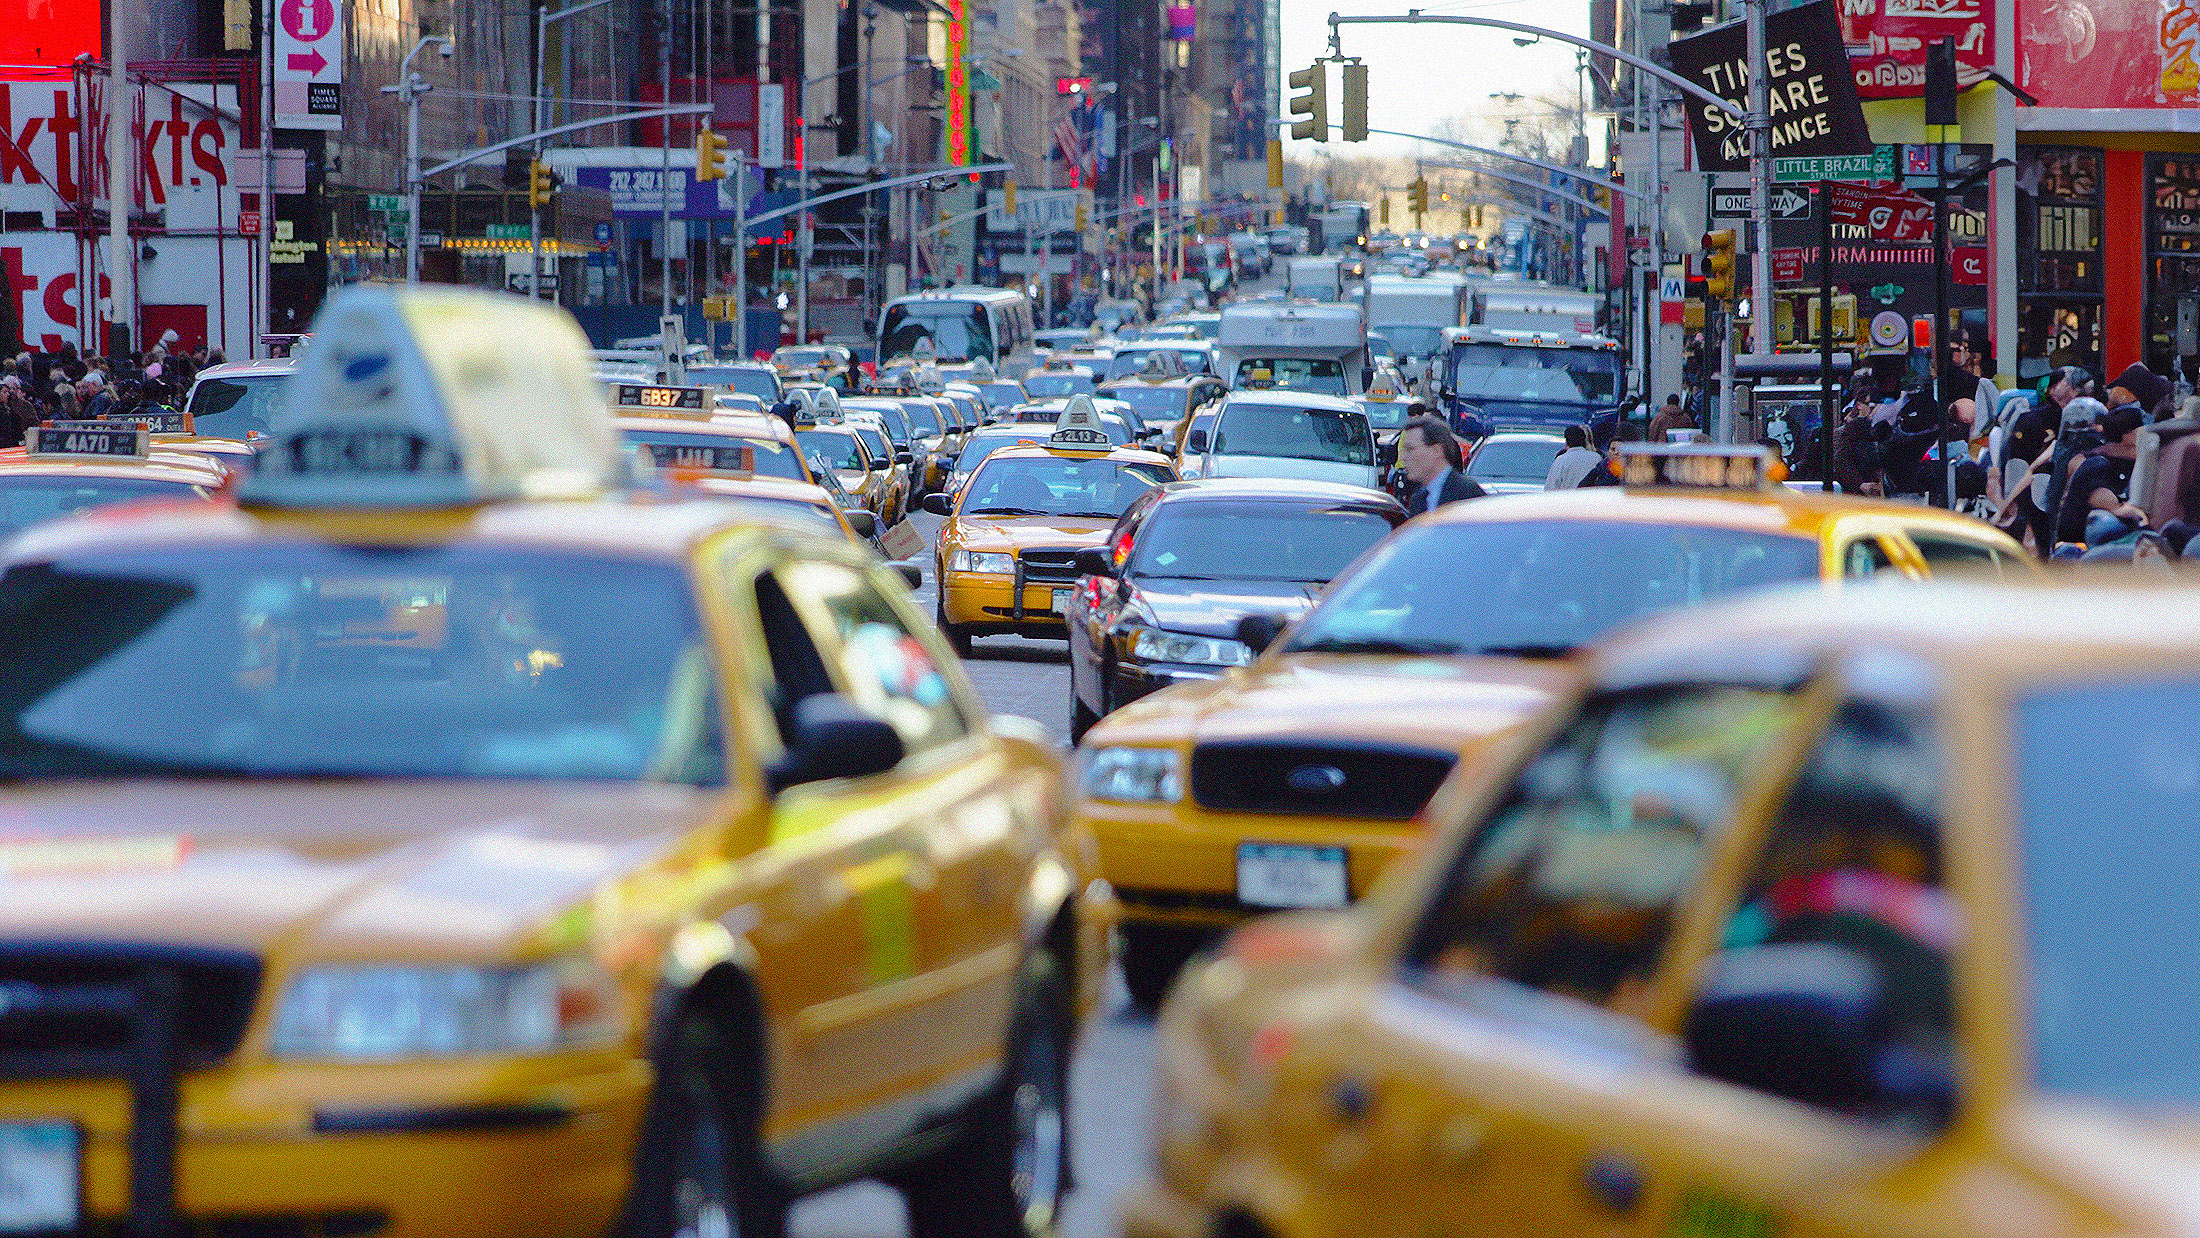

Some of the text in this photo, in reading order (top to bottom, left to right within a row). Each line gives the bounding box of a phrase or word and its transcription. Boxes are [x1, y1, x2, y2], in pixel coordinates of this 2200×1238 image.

[1703, 75, 1829, 133] SQARE
[1725, 113, 1831, 160] ALANCE
[1776, 158, 1871, 174] LITTLE BRAZIL
[1725, 197, 1797, 209] ONE WAY
[1831, 197, 1864, 211] NYTIME
[641, 388, 681, 407] 6B37
[65, 433, 109, 453] 4A70
